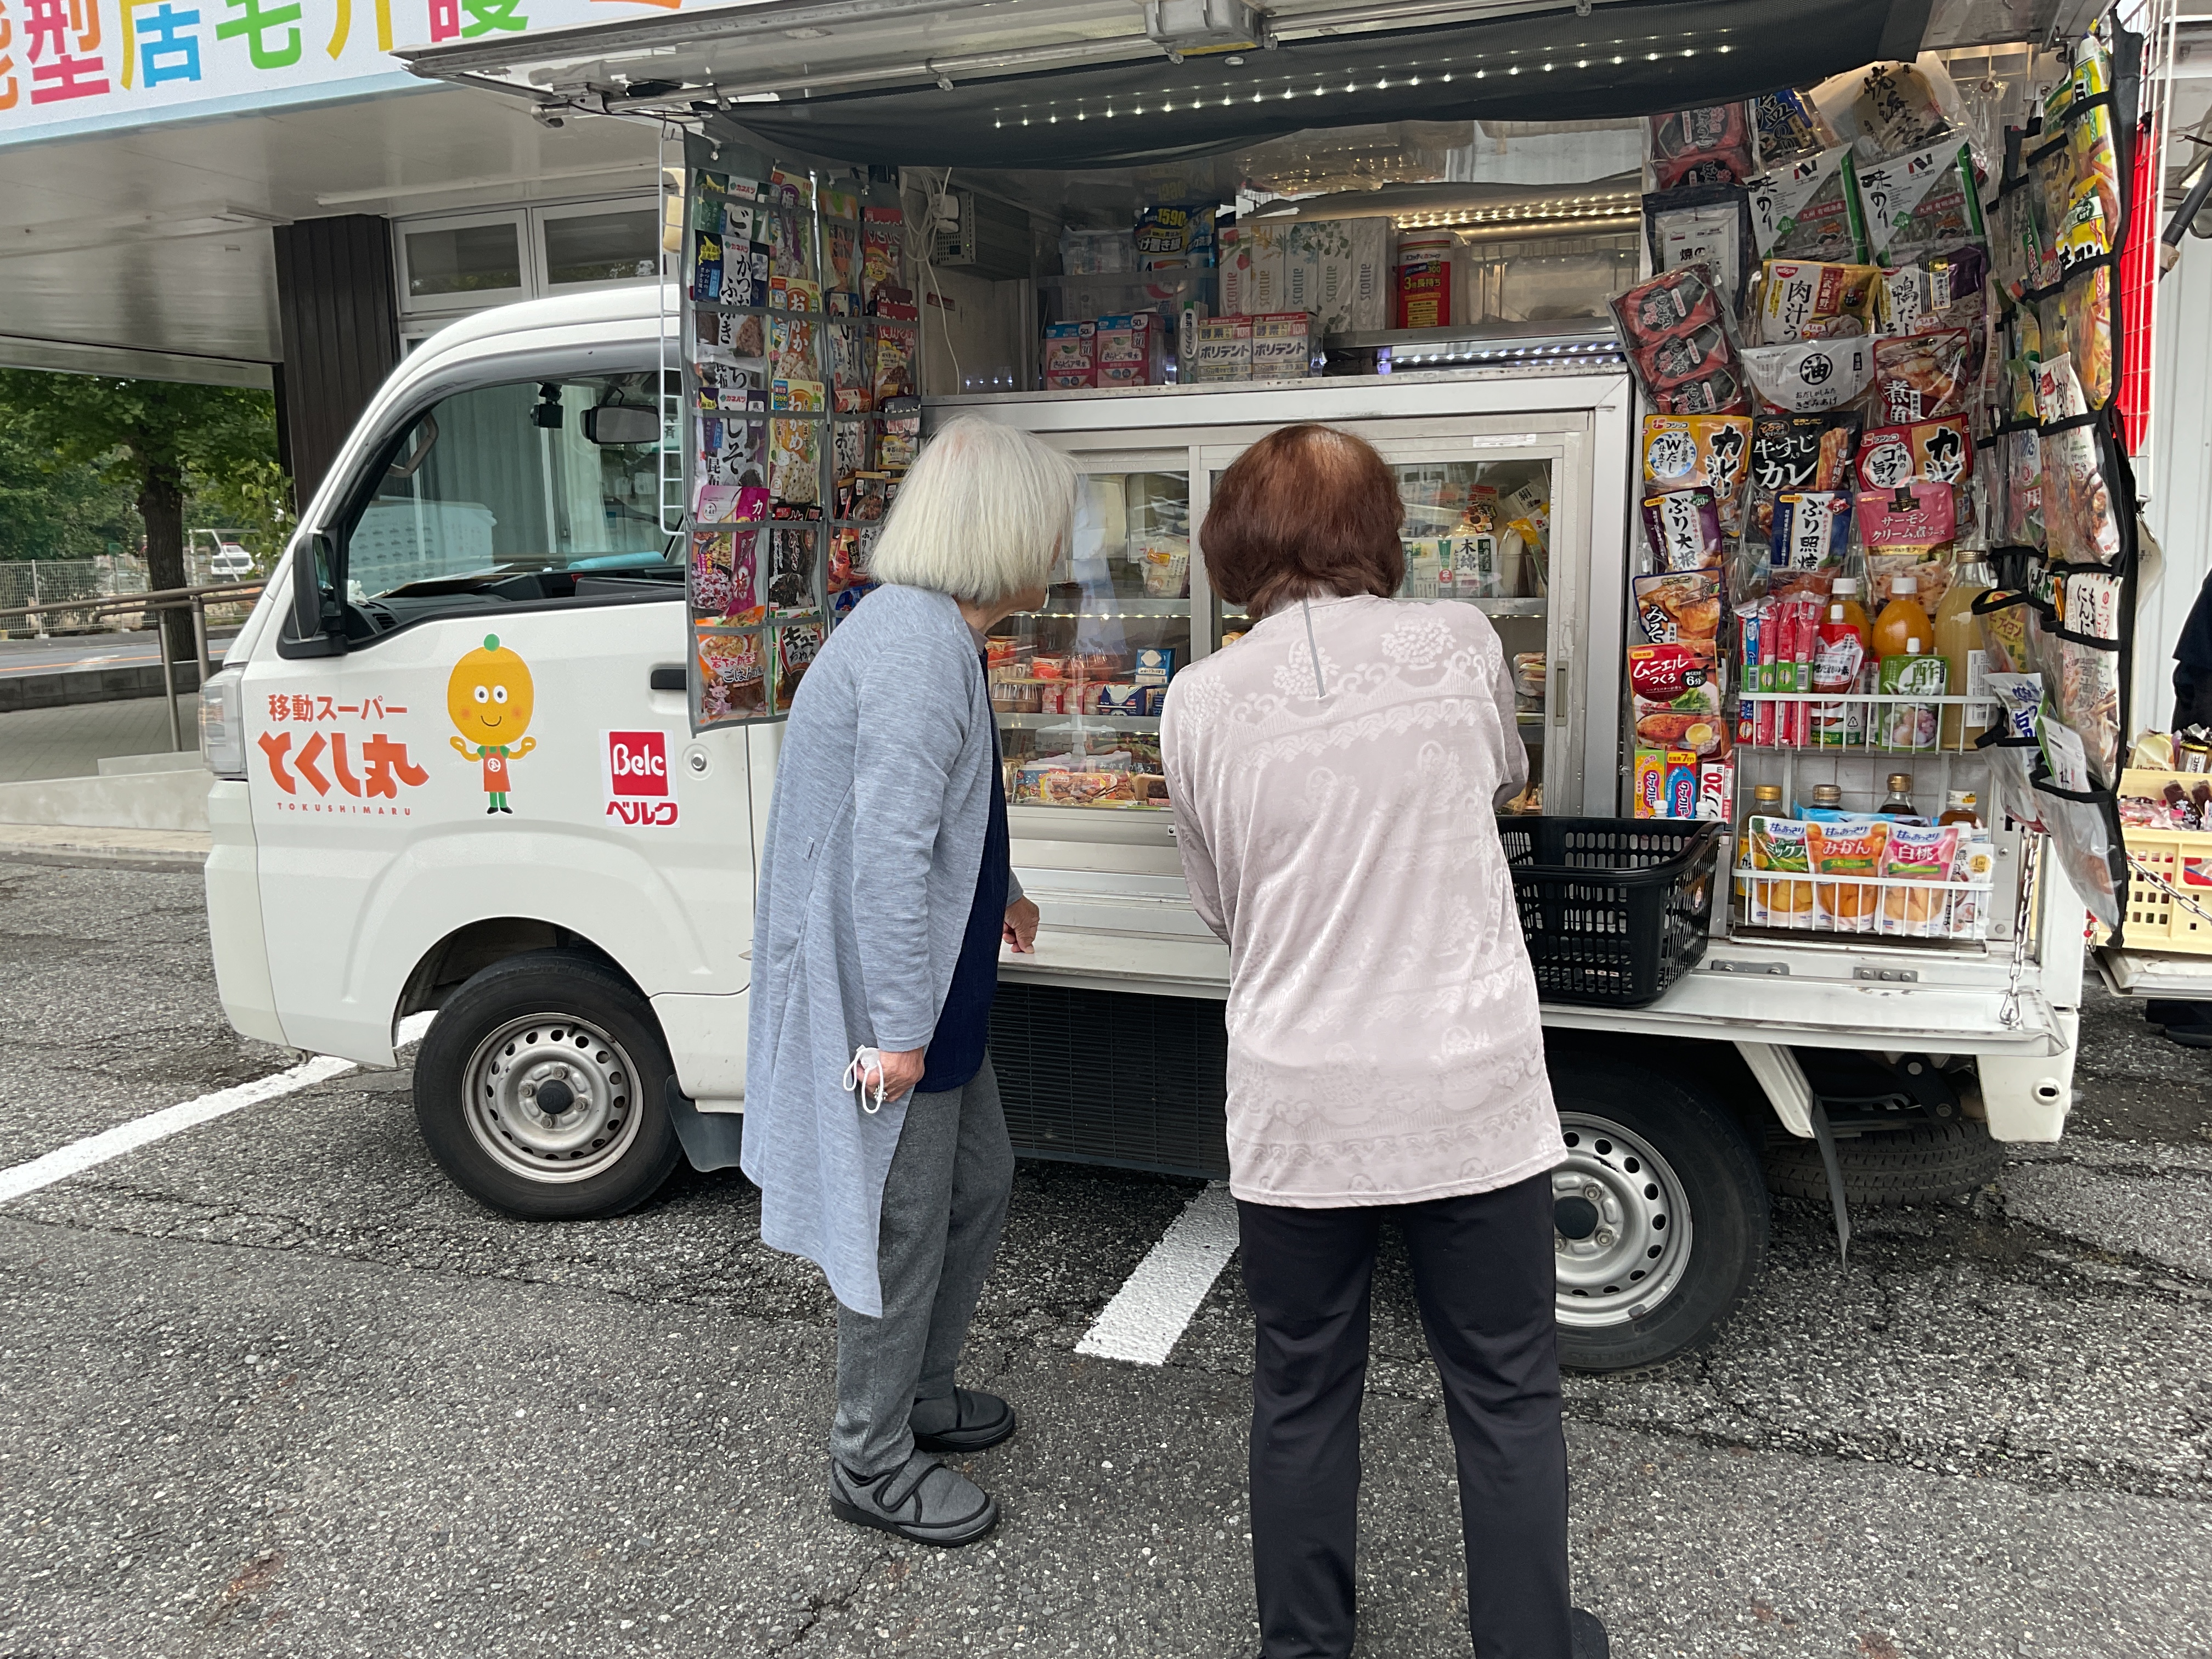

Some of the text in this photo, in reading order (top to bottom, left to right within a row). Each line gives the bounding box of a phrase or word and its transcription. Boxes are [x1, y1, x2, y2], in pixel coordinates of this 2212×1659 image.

[1748, 176, 1779, 233] 味のり
[1860, 168, 1893, 228] 味のり
[1227, 273, 1238, 308] scottie
[1260, 271, 1270, 307] scottie
[1293, 268, 1304, 304] scottie
[1326, 266, 1337, 302] scottie
[1361, 263, 1372, 301] scottie
[791, 294, 809, 352] おかか
[1784, 280, 1812, 341] 肉汁う
[1200, 345, 1250, 359] ポリデント
[1254, 342, 1305, 357] ポリデント
[1802, 356, 1829, 383] 油
[1795, 397, 1837, 410] きざみあげ
[1796, 387, 1836, 399] おだしがしみた
[788, 395, 803, 451] わかめ
[1657, 445, 1666, 467] 仕立て
[1665, 439, 1681, 475] Wだし
[1753, 435, 1816, 459] 牛すじ
[1895, 443, 1906, 469] 牛肉の
[1706, 456, 1719, 496] うど
[1872, 461, 1886, 484] 旨み
[1882, 449, 1898, 485] コクと
[1668, 496, 1697, 568] ぶり大根
[1797, 497, 1825, 571] ぶり照焼
[1881, 513, 1929, 528] サーモン
[1459, 539, 1477, 571] 木綿
[2077, 584, 2091, 635] にんに
[1645, 605, 1668, 644] みそ
[783, 626, 819, 651] キュー
[789, 648, 816, 663] ちゃん
[1633, 654, 1689, 679] ムニエル
[724, 665, 764, 681] ごはんの素
[1649, 673, 1676, 685] つくろ
[1686, 676, 1701, 686] 6分
[1912, 660, 1936, 686] 酢
[268, 694, 408, 722] 移動スーパー
[257, 730, 430, 800] とくし丸
[613, 743, 665, 776] Belc
[277, 802, 411, 816] TOKUSHIMARU
[606, 801, 679, 826] ベルク
[1766, 843, 1808, 858] ミックス
[1822, 840, 1871, 855] みかん
[1898, 844, 1934, 860] 白桃
